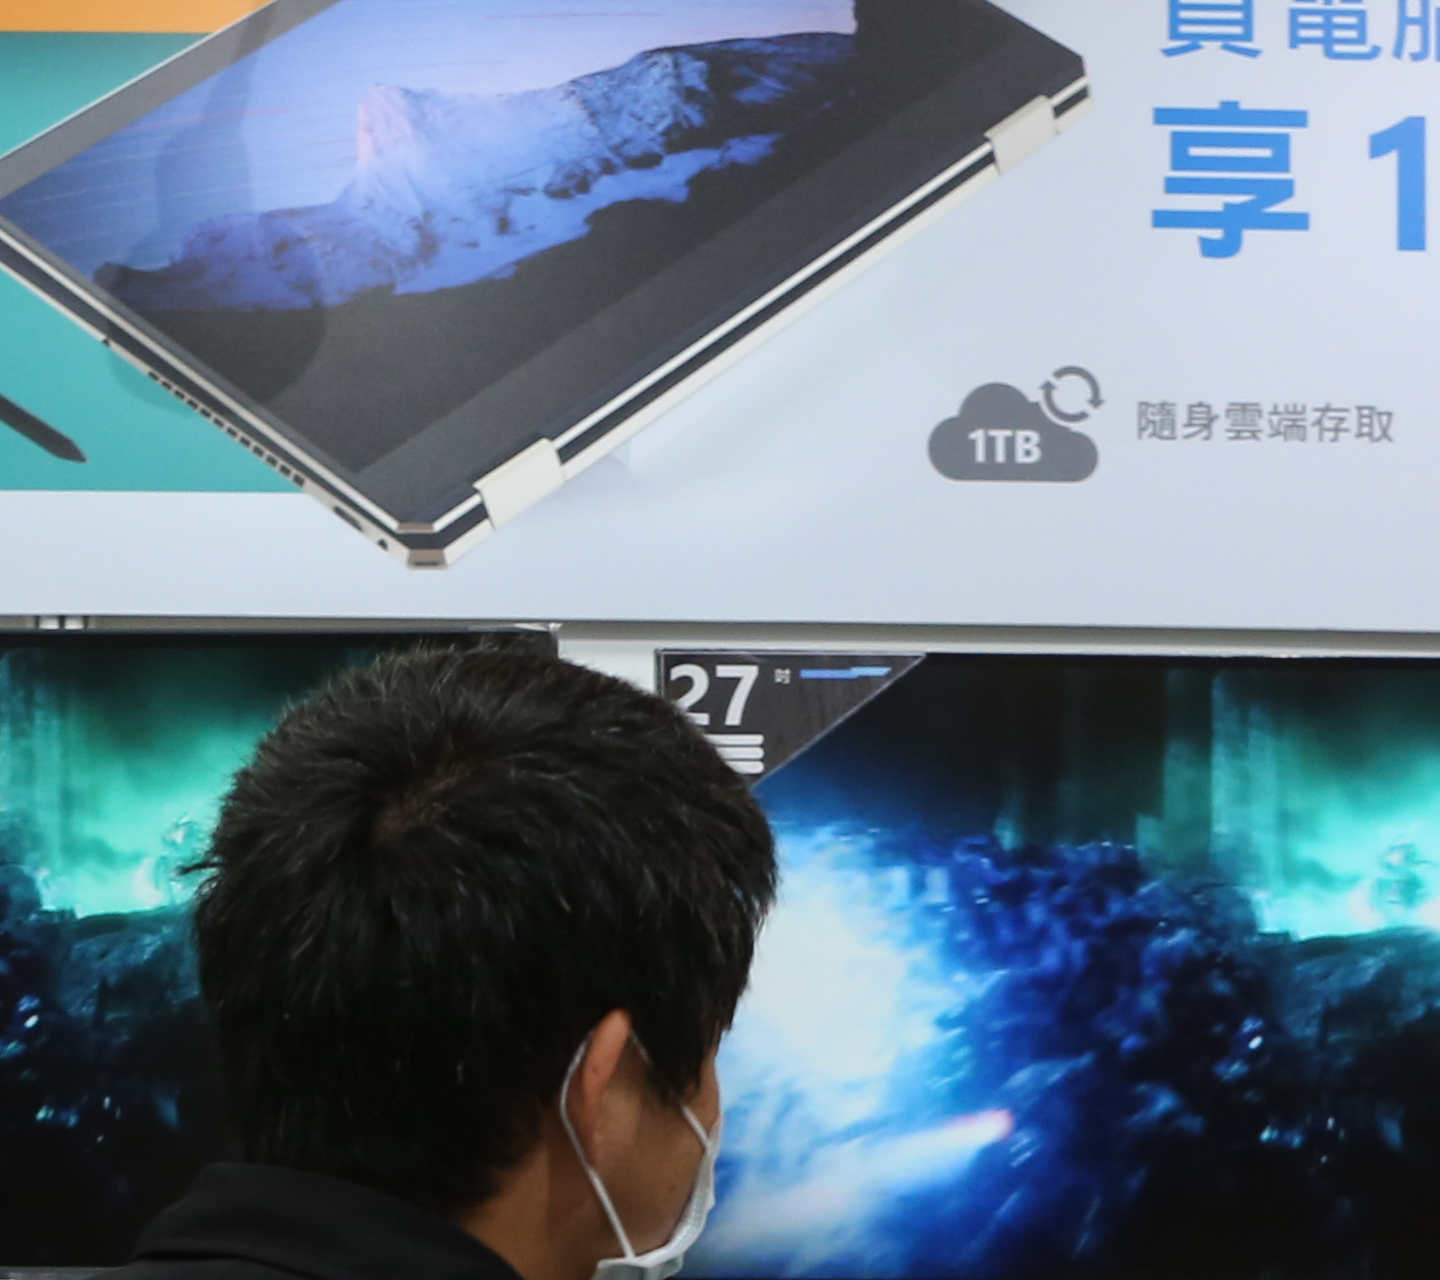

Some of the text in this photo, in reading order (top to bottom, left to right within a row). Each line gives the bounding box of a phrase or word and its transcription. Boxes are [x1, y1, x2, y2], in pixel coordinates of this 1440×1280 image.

[1150, 100, 1312, 261] 享
[967, 430, 1042, 466] 1TB
[1134, 399, 1396, 444] 隨身雲端存取
[669, 663, 760, 727] 27
